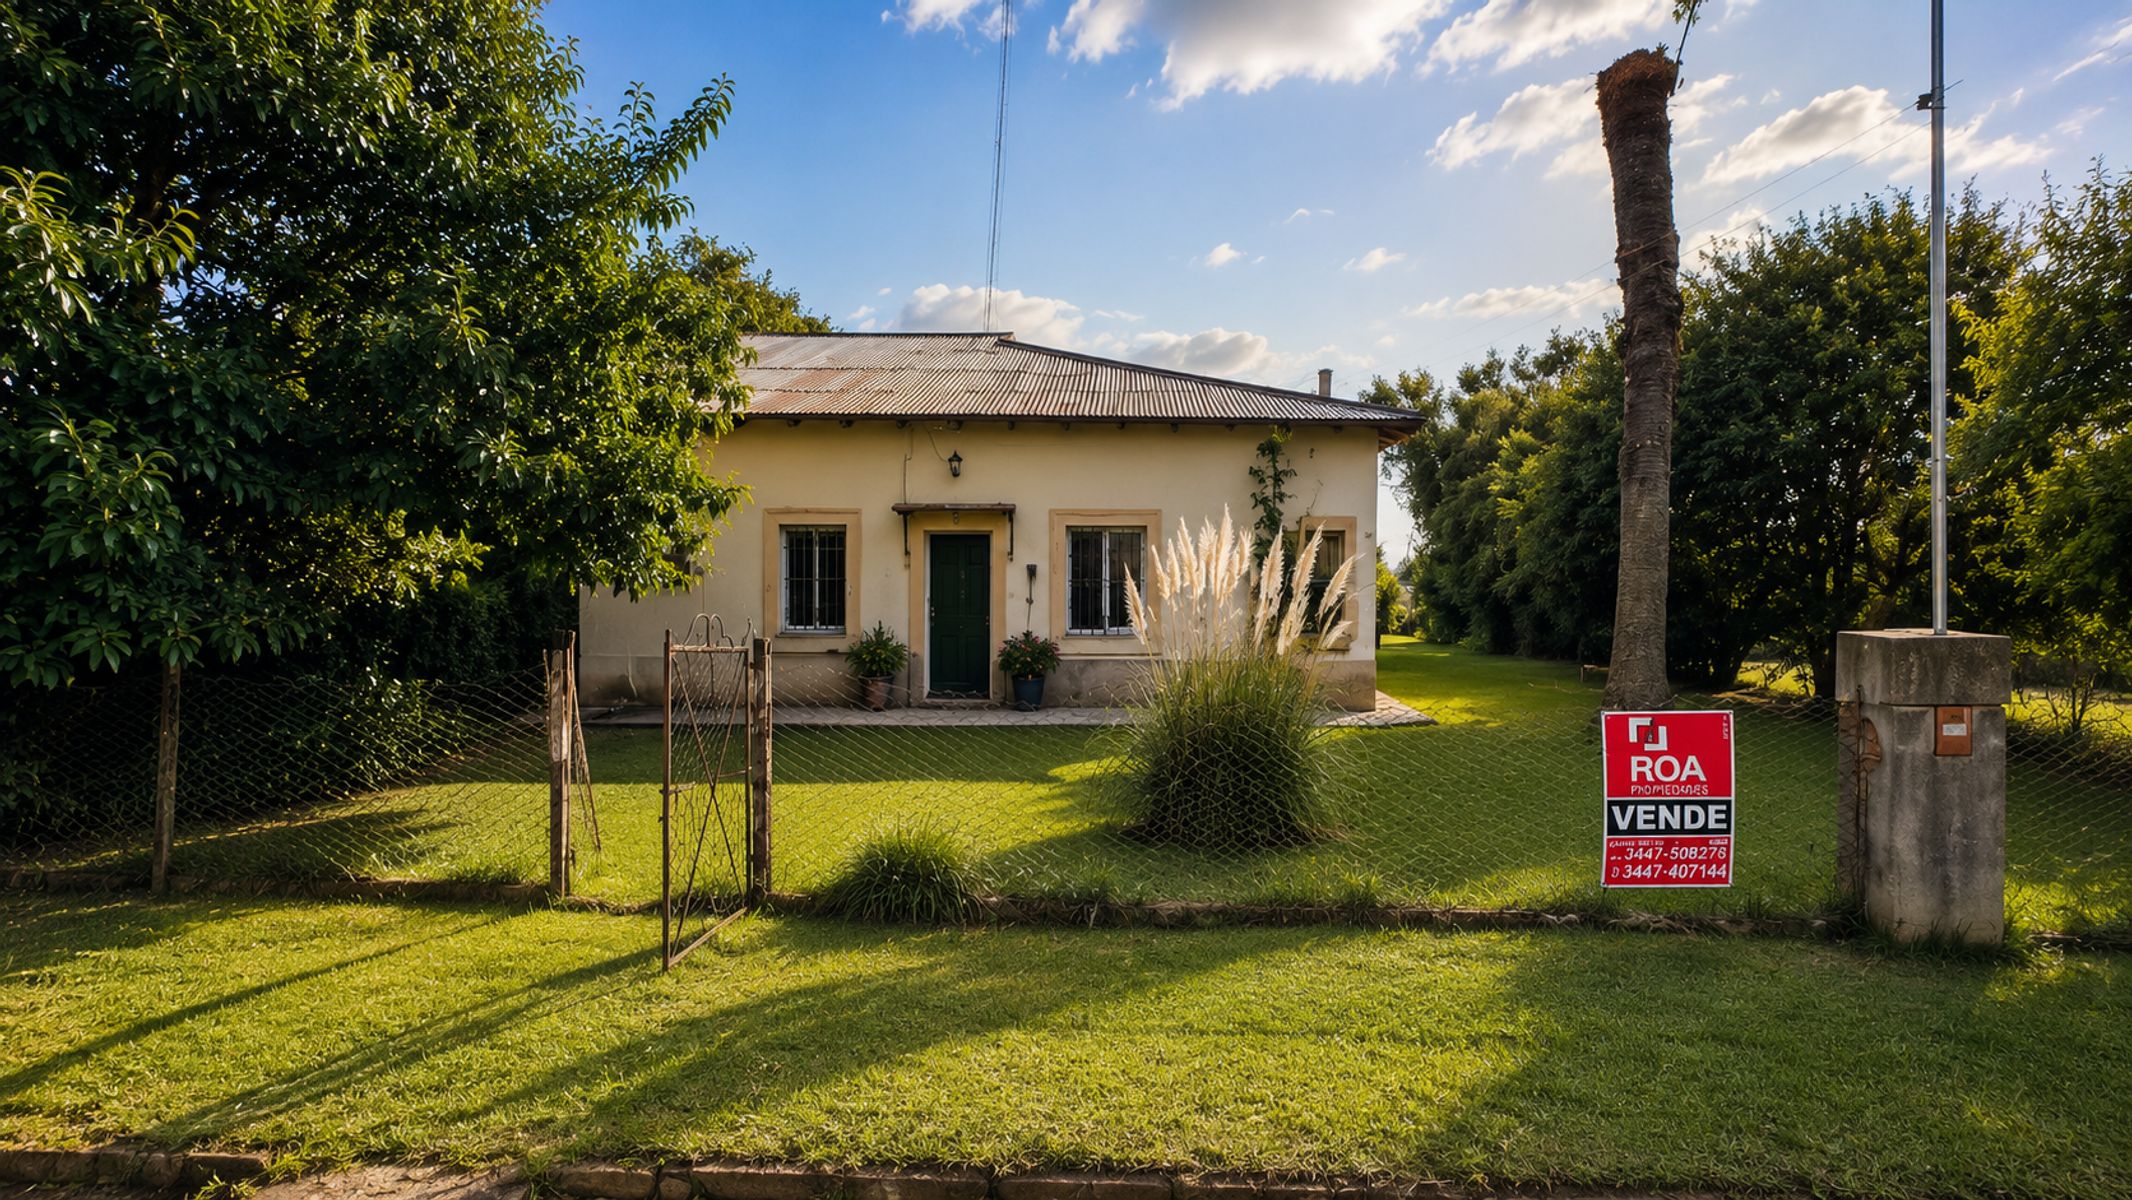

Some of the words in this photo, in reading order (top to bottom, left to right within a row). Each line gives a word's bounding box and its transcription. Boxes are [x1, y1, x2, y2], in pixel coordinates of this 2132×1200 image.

[1631, 755, 1707, 782] ROA
[1611, 804, 1728, 830] VENDE
[1624, 846, 1727, 860] 3447-508276
